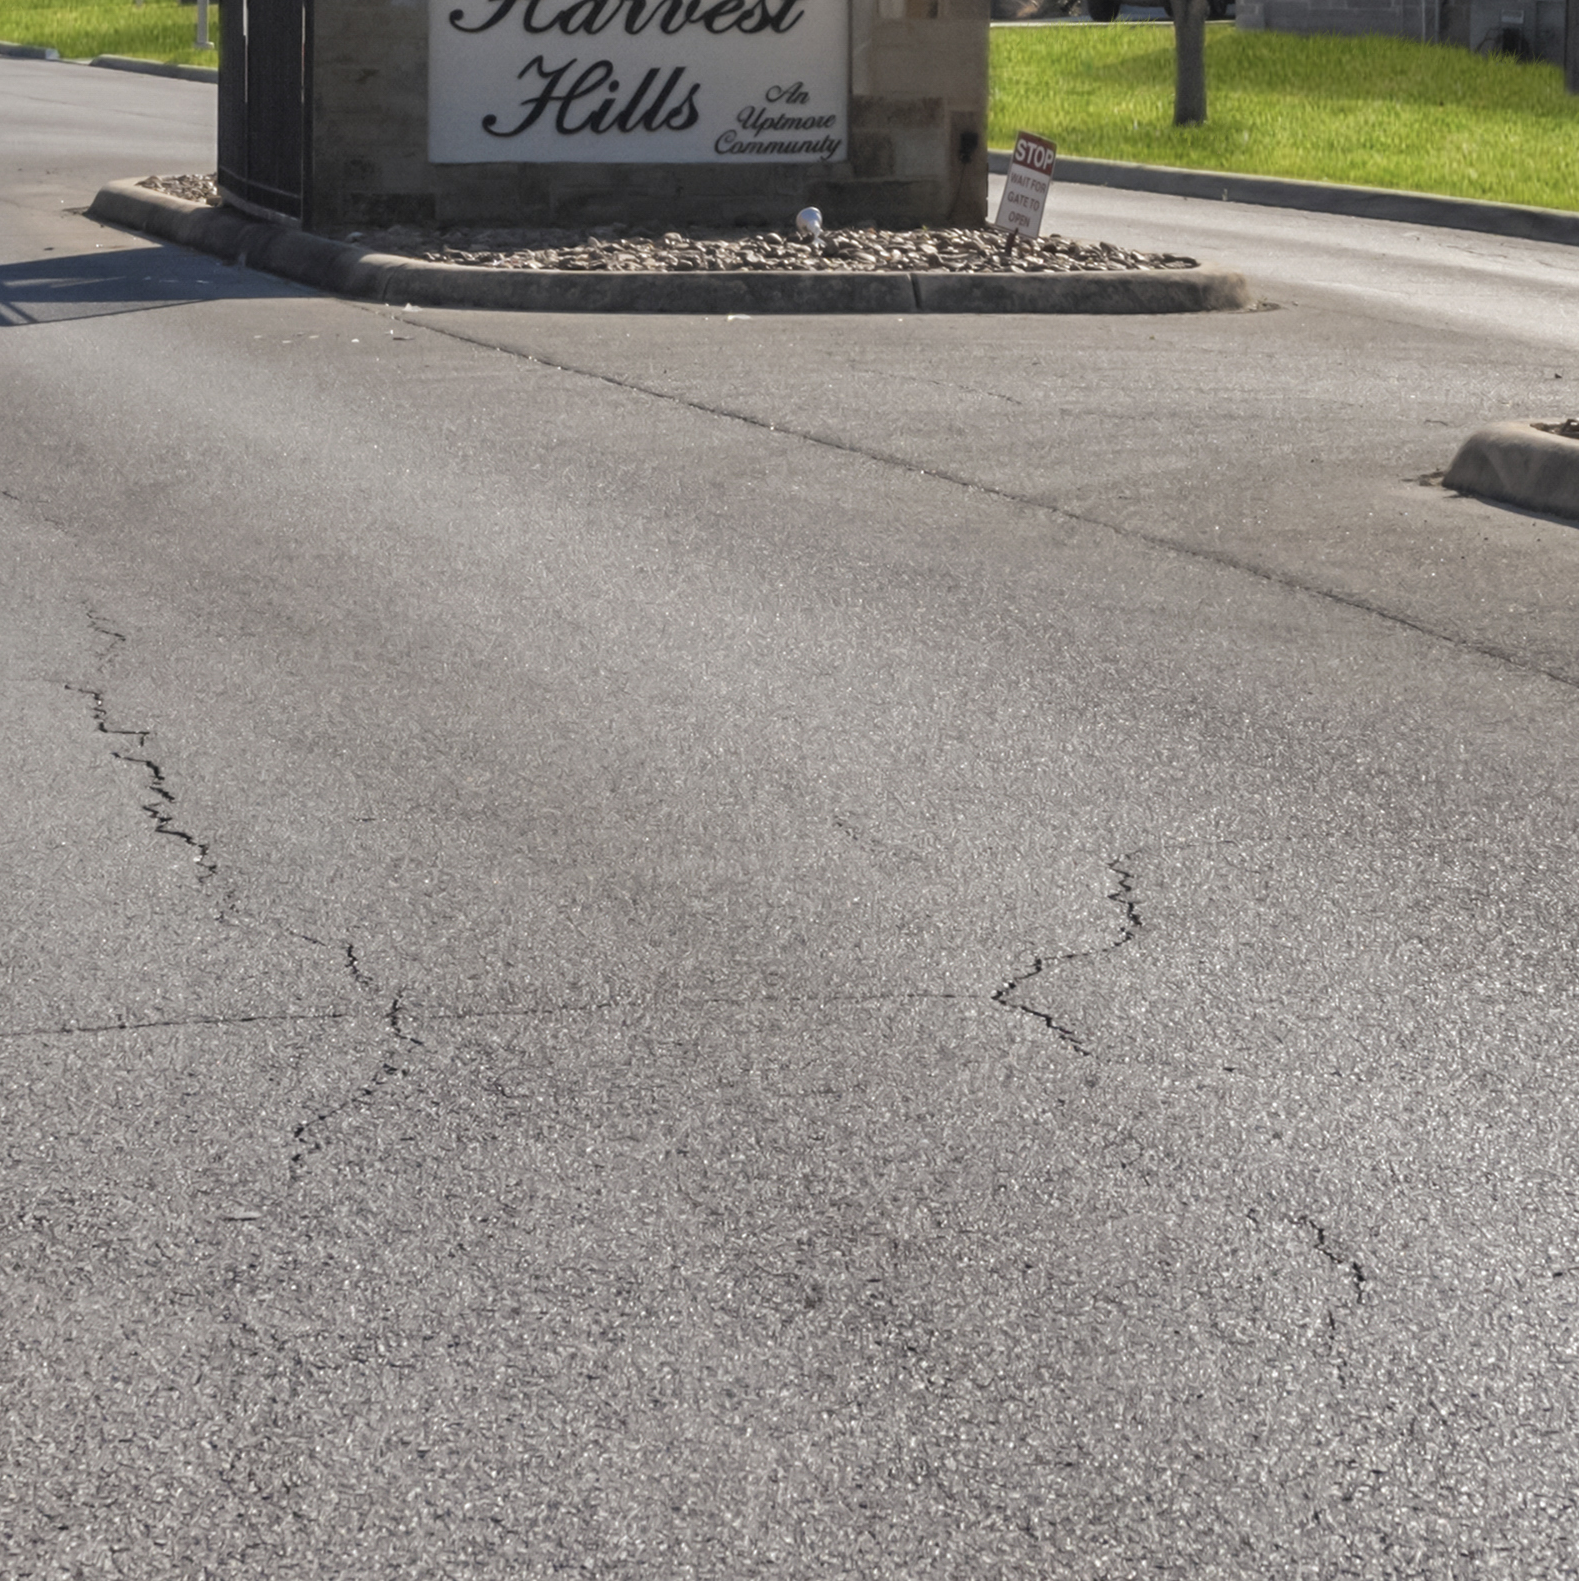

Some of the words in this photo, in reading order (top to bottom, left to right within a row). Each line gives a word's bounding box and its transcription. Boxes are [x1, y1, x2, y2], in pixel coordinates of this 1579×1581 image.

[481, 55, 701, 137] Hills
[765, 81, 810, 105] An
[736, 105, 837, 138] Uptmore
[714, 129, 842, 160] Community
[1015, 138, 1055, 170] STOP
[1010, 172, 1031, 188] WAIT
[1031, 179, 1047, 194] FOR
[1007, 191, 1030, 209] GATE
[1030, 199, 1041, 212] TO
[1008, 211, 1031, 227] OPEN
